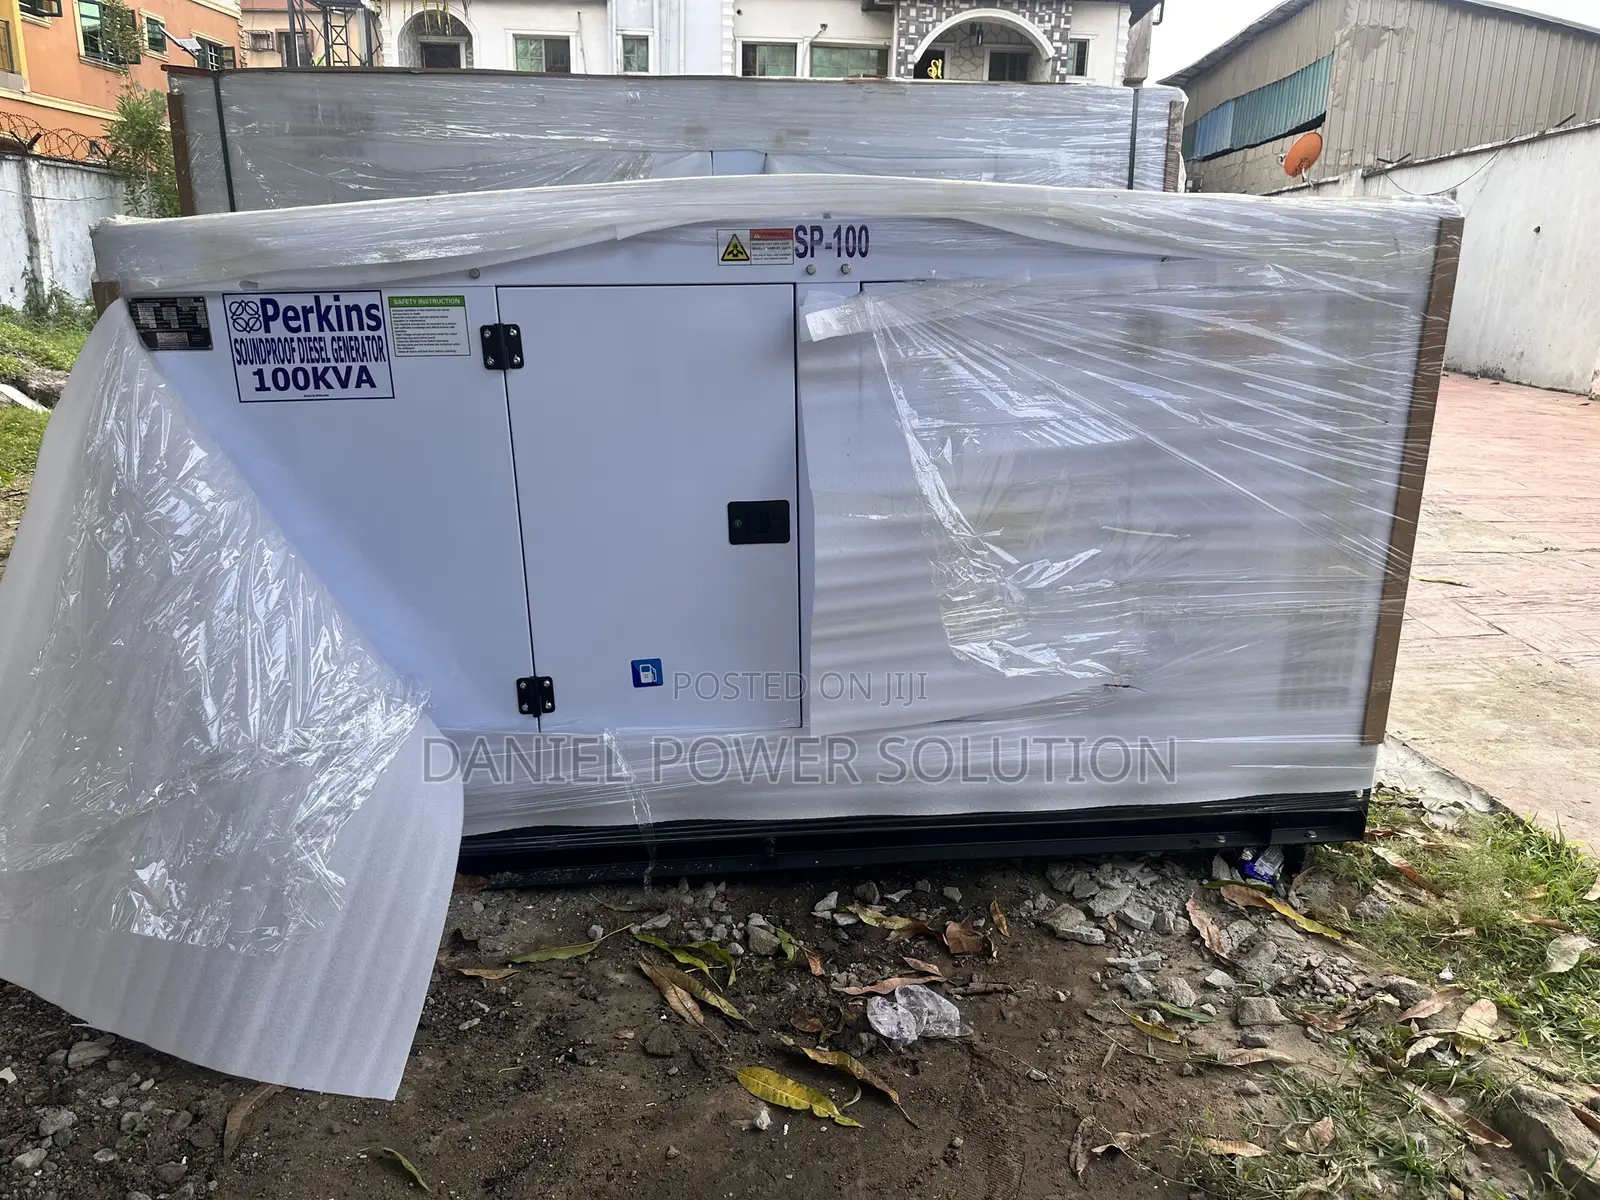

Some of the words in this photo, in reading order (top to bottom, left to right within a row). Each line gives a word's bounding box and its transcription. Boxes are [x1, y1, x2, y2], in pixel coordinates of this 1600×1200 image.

[795, 224, 870, 259] SP-100
[259, 294, 382, 334] Perkins
[418, 297, 461, 305] INSTRUCTION
[234, 336, 296, 366] SOUNDPROOF
[296, 336, 331, 364] DIESEL
[331, 334, 387, 364] GENERATOR
[252, 365, 377, 391] 100KVA
